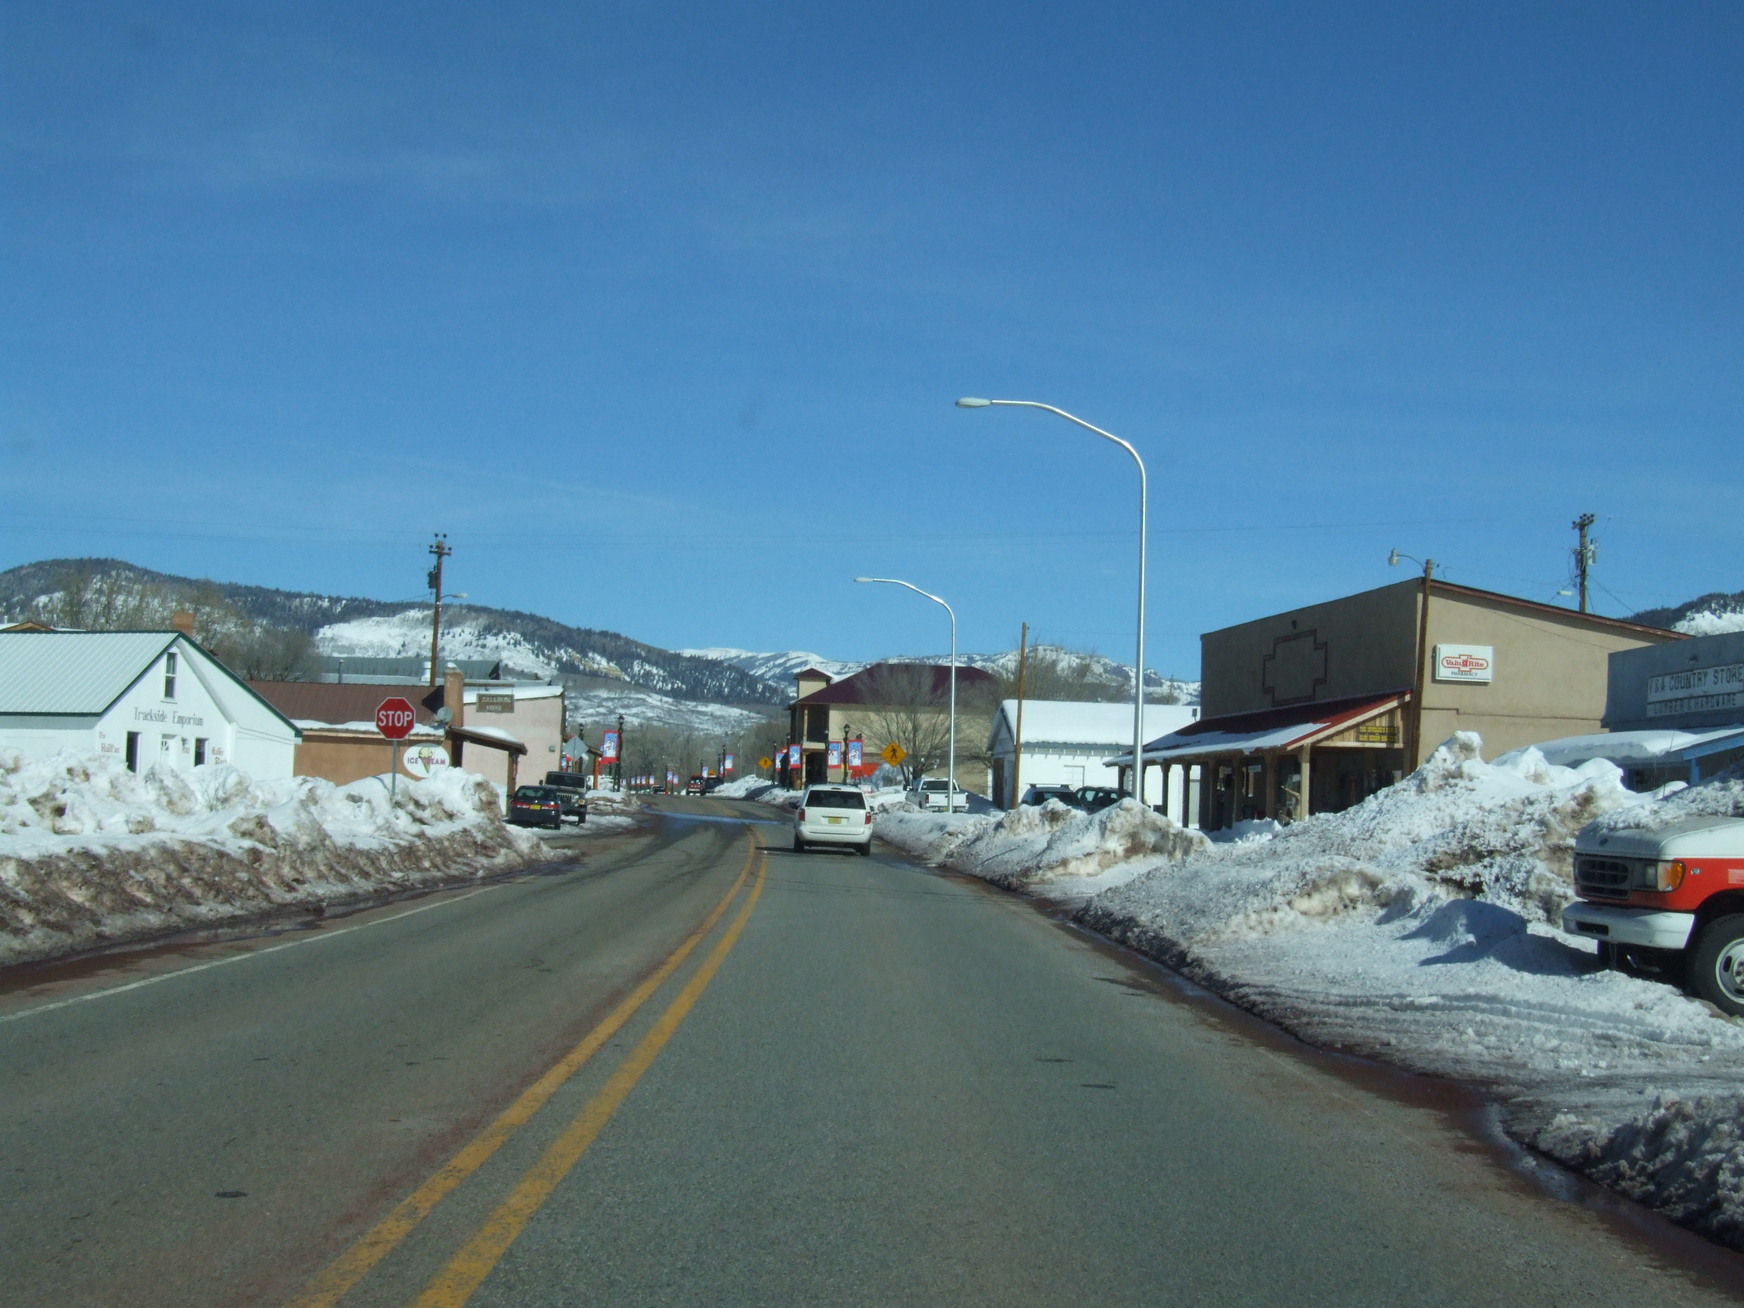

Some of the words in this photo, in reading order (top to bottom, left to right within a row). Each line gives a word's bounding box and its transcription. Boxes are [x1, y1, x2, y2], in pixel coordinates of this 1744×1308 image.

[1669, 671, 1708, 691] COUNTRY
[1712, 666, 1744, 685] STORE
[1654, 699, 1684, 714] LUMBER
[1695, 693, 1737, 710] HARDWARE
[134, 707, 168, 723] Trackside
[172, 711, 204, 728] Emporium
[378, 710, 413, 727] STOP
